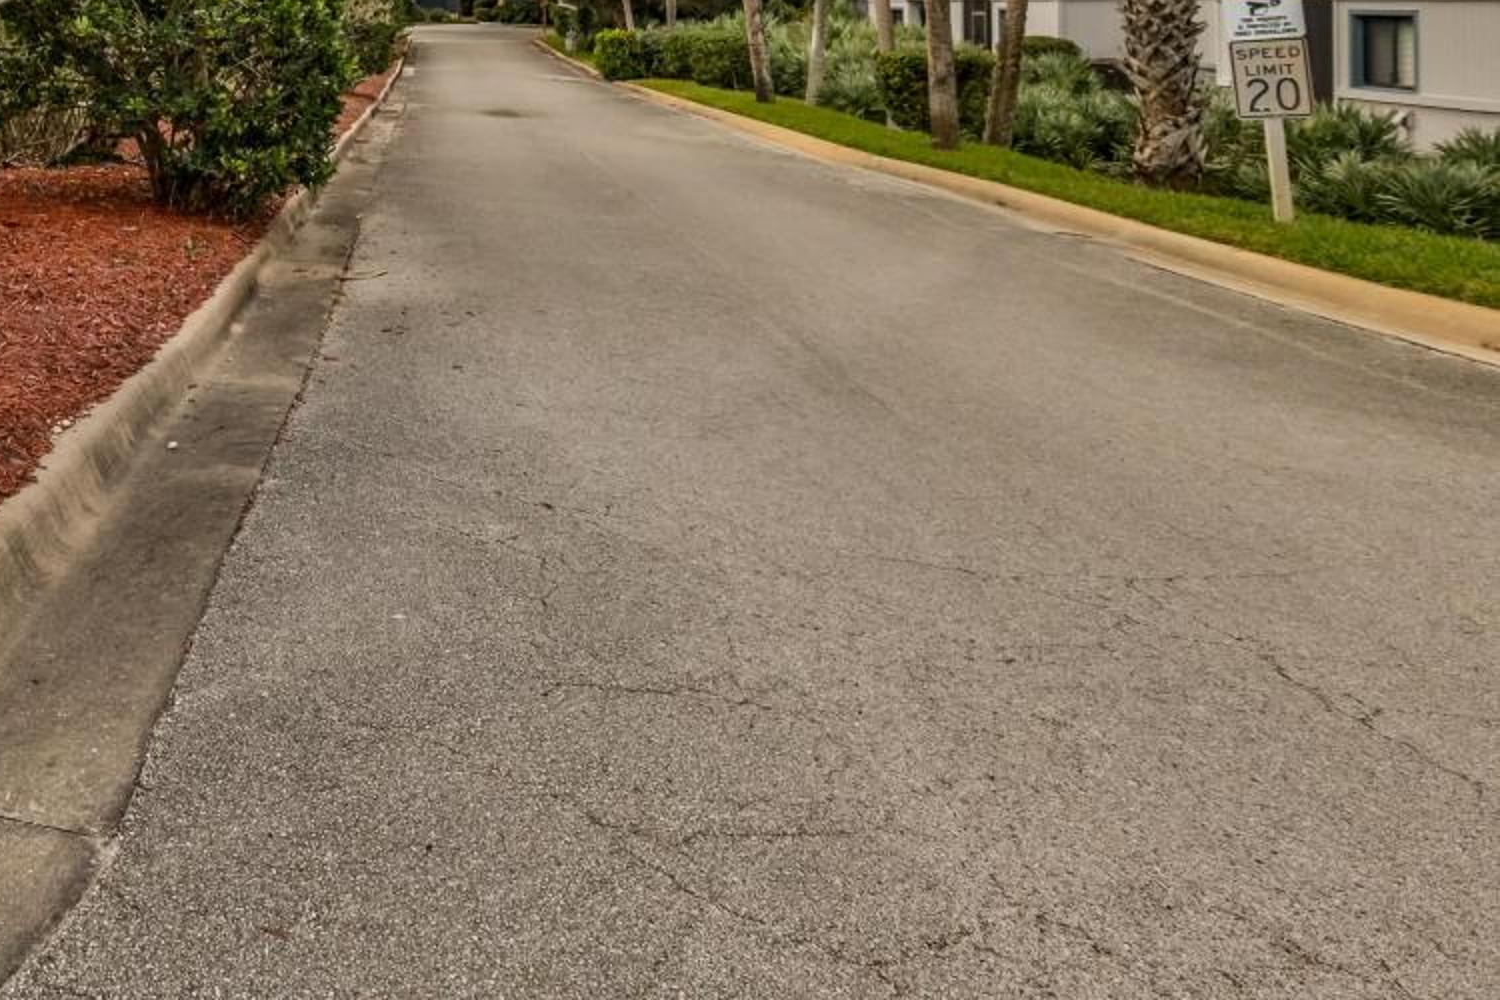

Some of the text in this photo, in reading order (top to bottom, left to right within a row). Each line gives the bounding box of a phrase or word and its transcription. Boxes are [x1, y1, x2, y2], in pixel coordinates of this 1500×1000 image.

[1235, 46, 1301, 61] SPEED
[1244, 63, 1295, 77] LIMIT
[1246, 77, 1301, 113] 20
